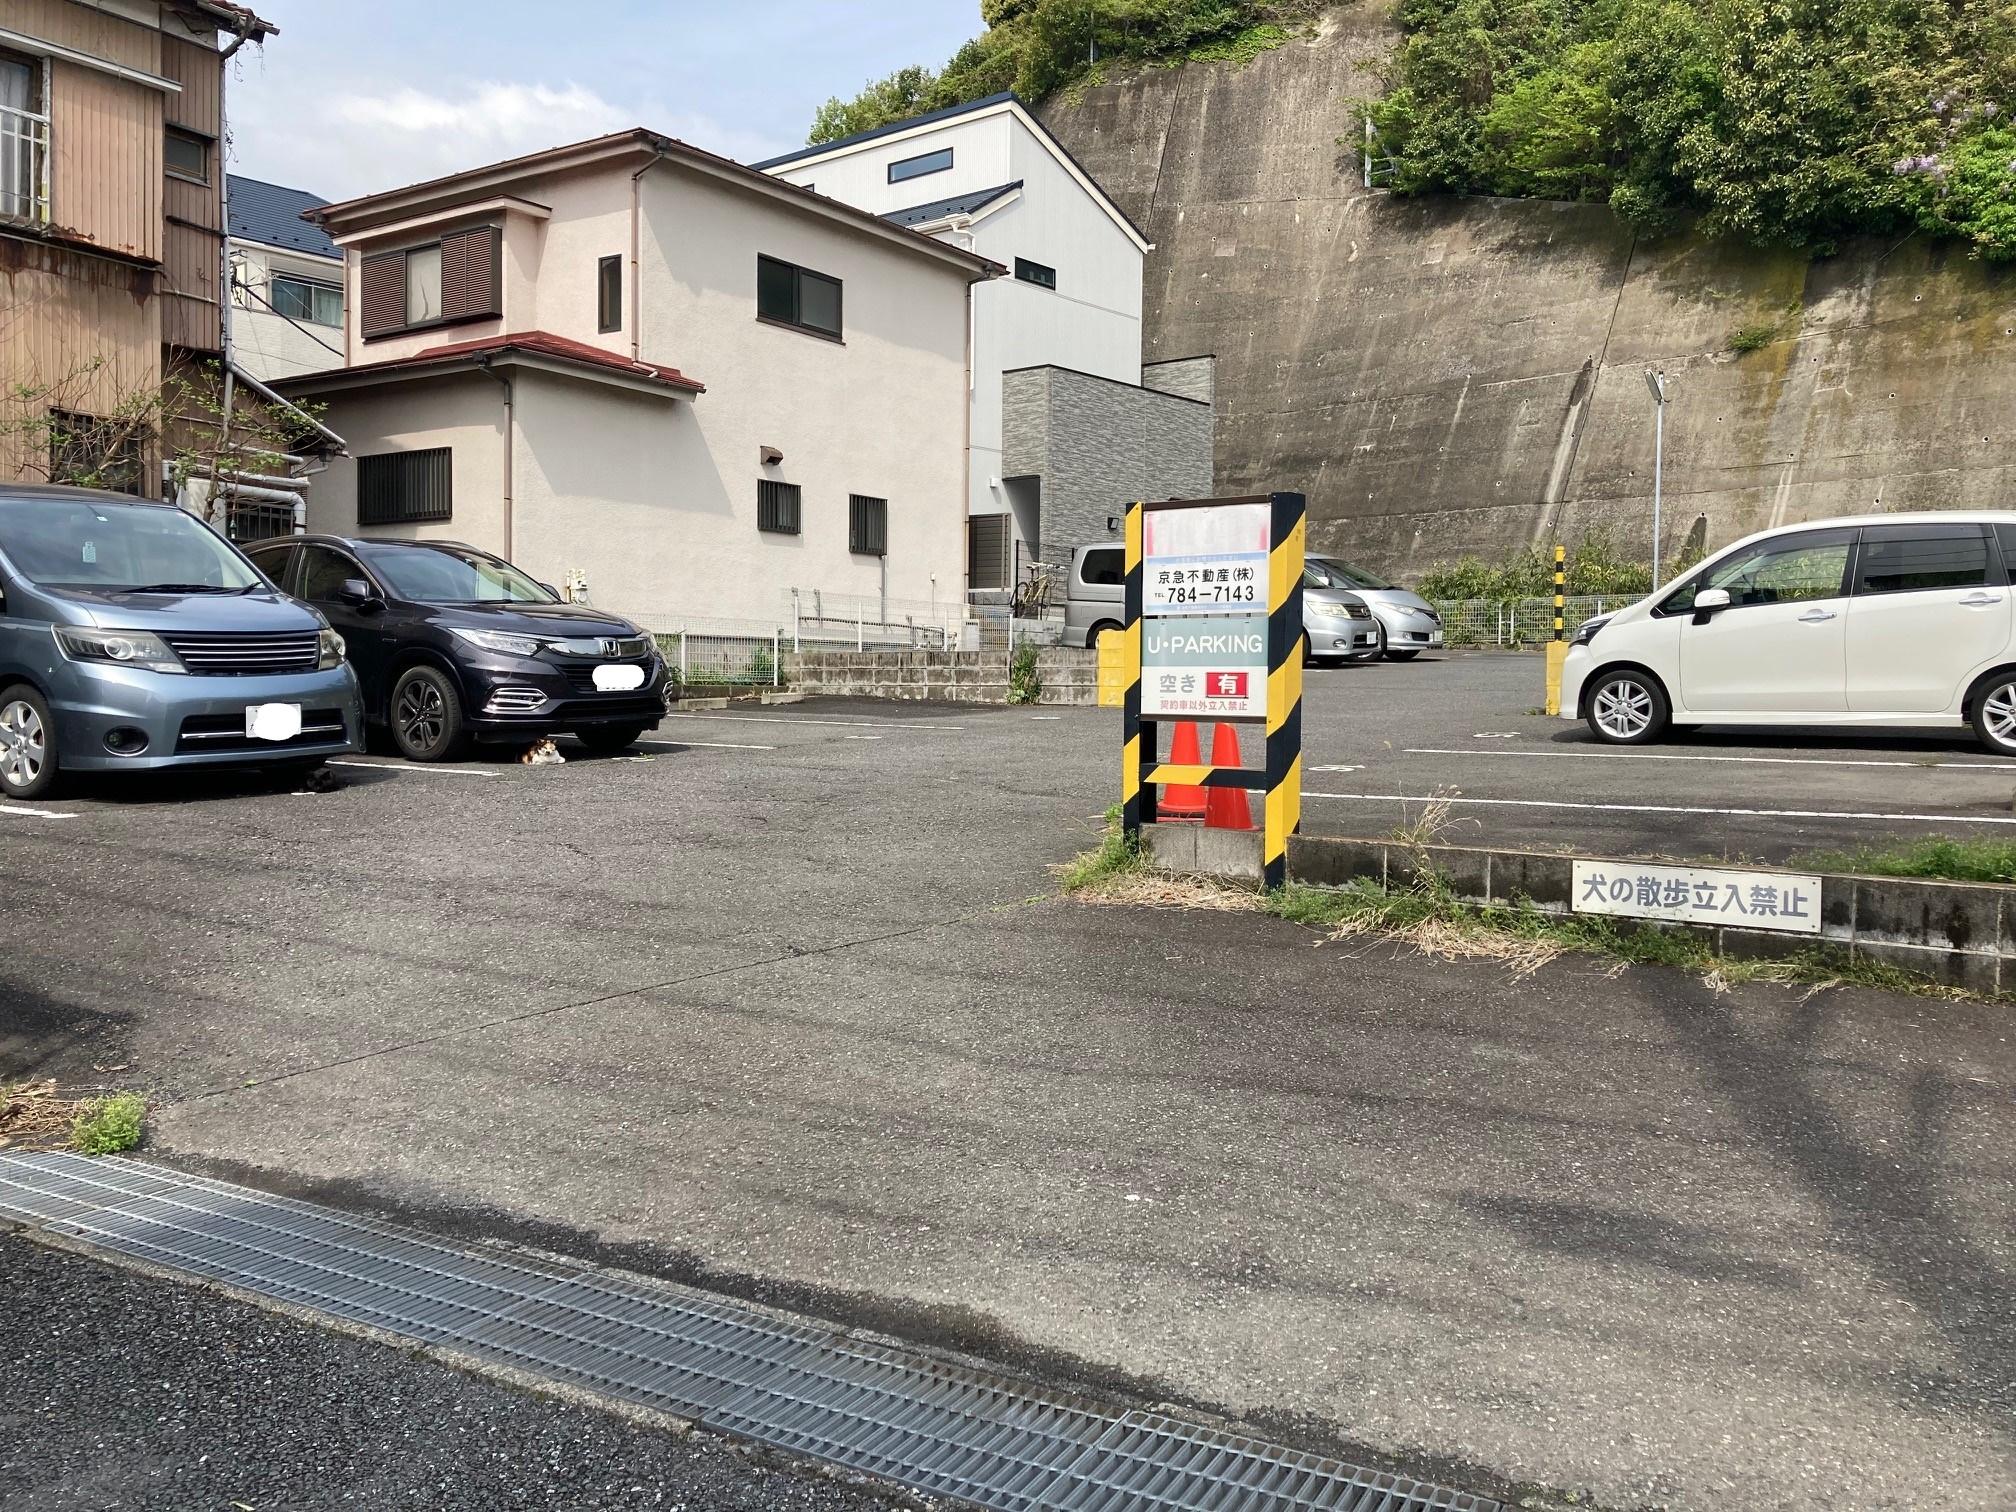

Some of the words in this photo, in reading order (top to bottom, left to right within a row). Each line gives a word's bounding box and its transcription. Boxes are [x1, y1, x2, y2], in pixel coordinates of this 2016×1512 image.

[1158, 567, 1254, 584] 京急不動産(株)
[1168, 585, 1254, 603] 784-7143
[1160, 674, 1195, 693] 空き
[1218, 674, 1238, 694] 有
[1160, 700, 1248, 711] 契約車以外立入禁止
[1582, 873, 1809, 918] 犬の散歩立入禁止
